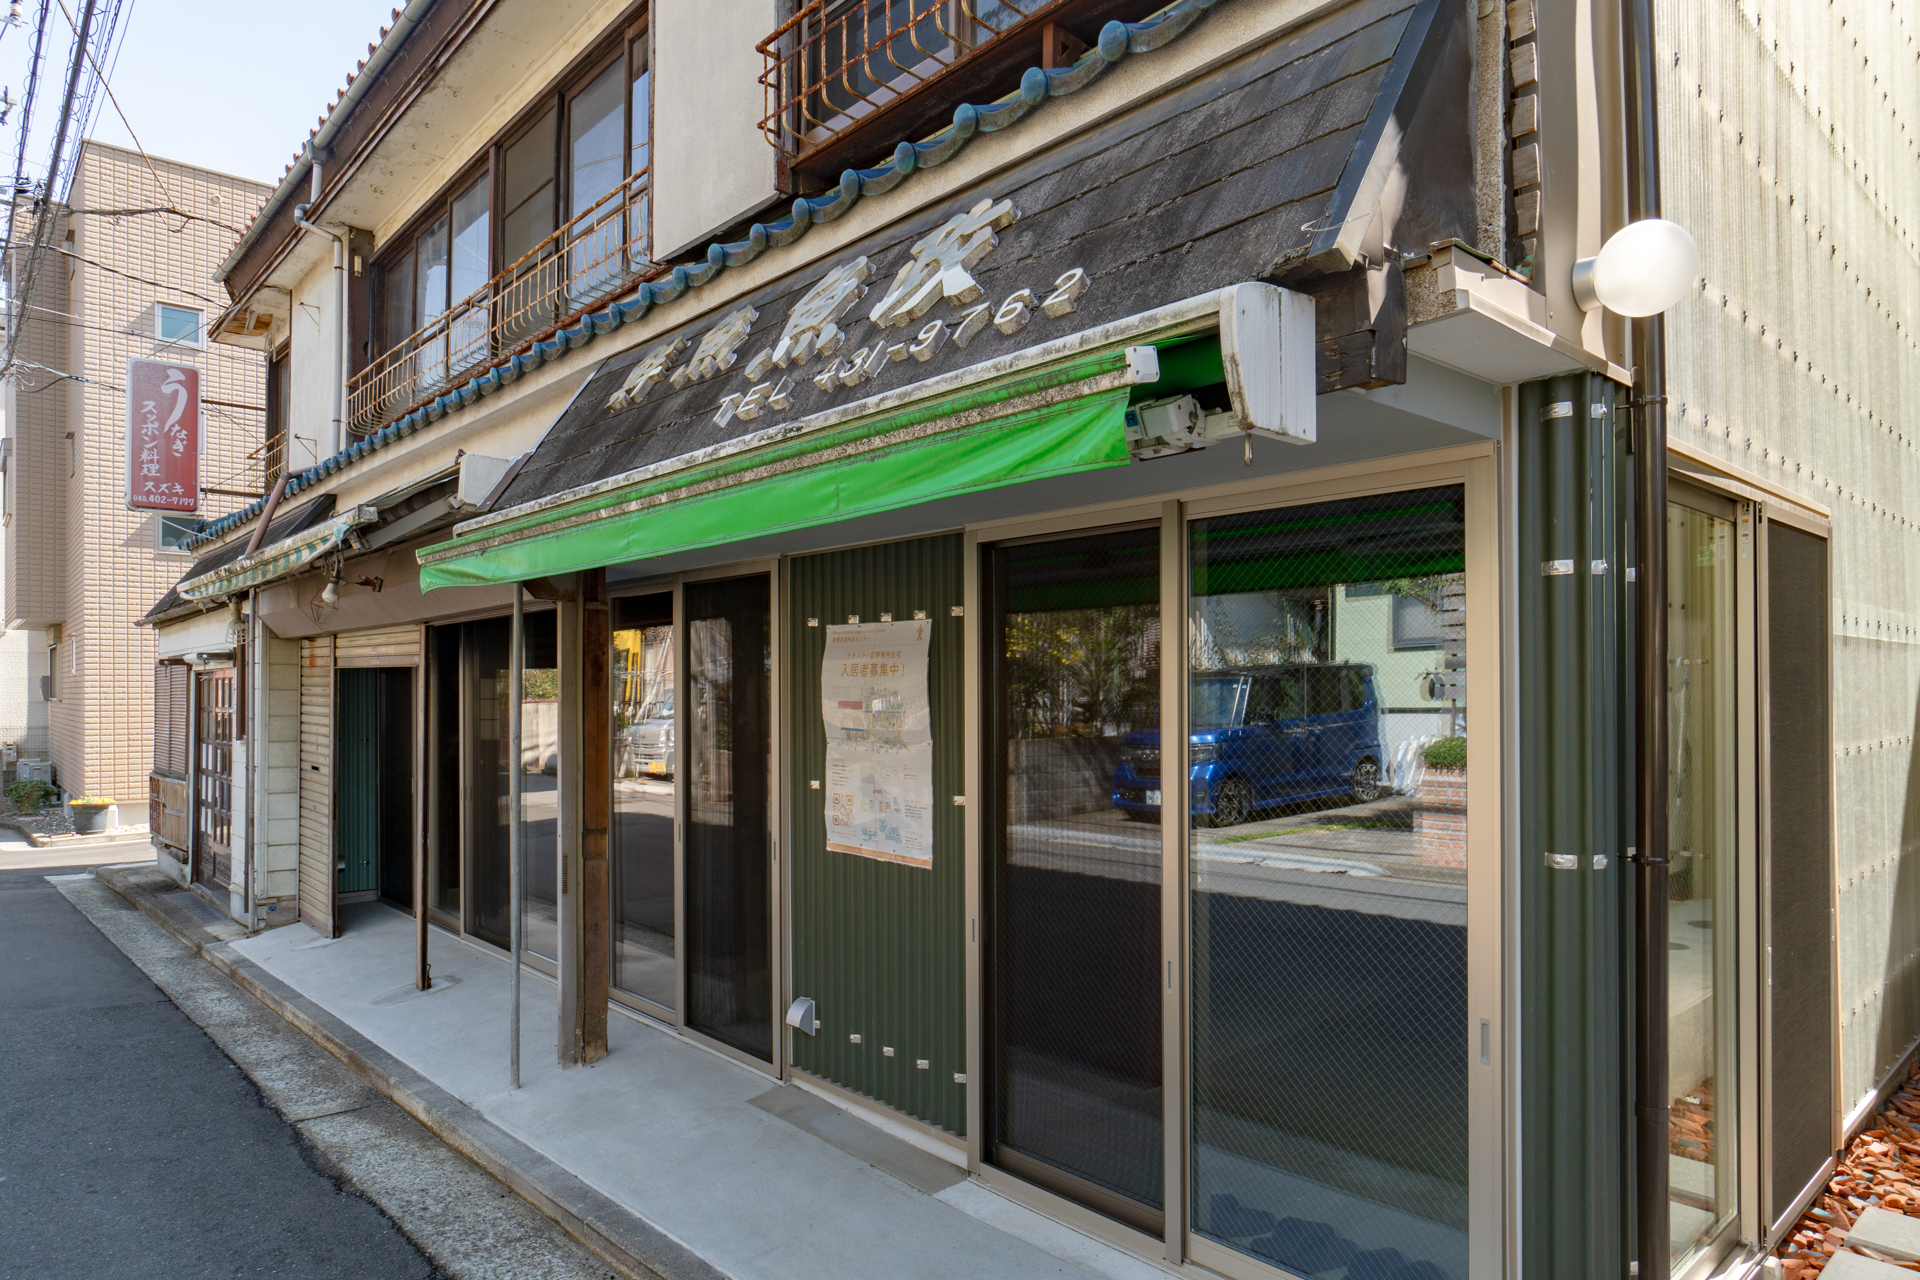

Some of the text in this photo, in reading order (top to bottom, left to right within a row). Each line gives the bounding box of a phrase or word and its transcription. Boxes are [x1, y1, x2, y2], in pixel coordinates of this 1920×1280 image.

[713, 267, 1091, 428] TEL 431-9762
[139, 400, 161, 477] スッポン料理
[161, 368, 188, 457] うなぎ
[1126, 413, 1136, 425] R
[143, 481, 185, 495] スズキ
